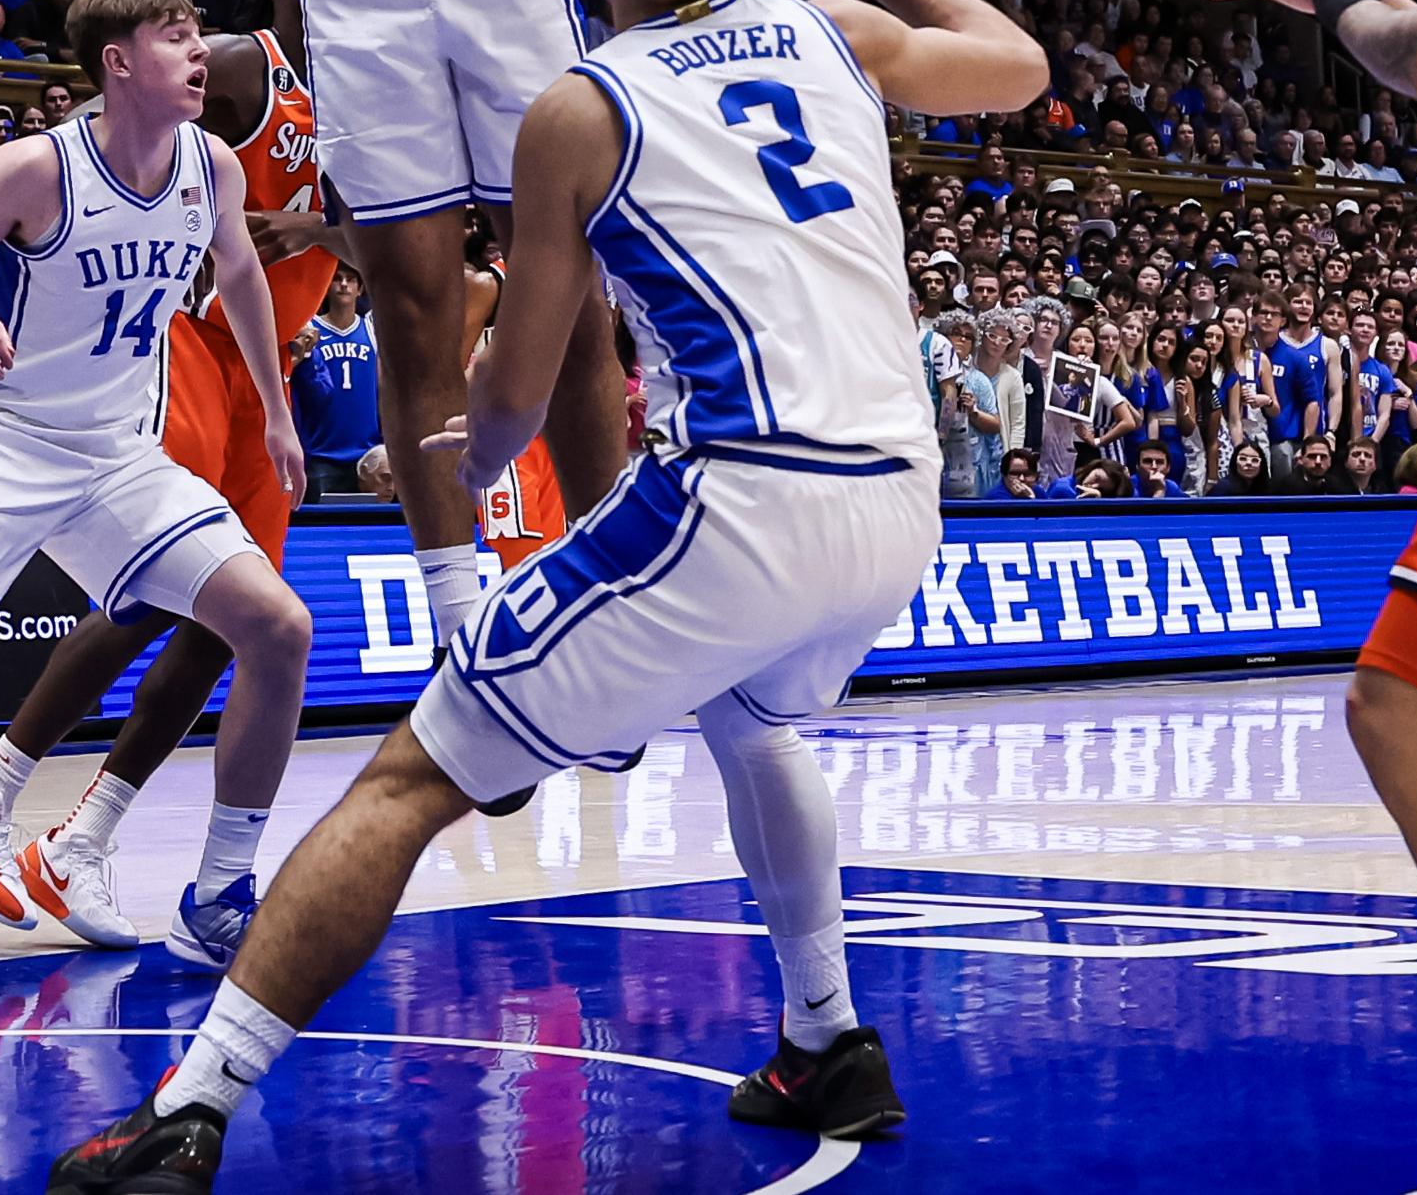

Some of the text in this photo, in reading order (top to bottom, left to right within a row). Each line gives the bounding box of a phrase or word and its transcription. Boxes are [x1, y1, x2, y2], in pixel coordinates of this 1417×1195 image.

[648, 23, 801, 77] BOOZER
[717, 78, 856, 224] 2
[75, 238, 204, 289] DUKE
[90, 287, 167, 358] 14
[320, 342, 371, 362] DUKE
[340, 361, 354, 391] 1
[491, 491, 511, 519] S
[503, 565, 558, 633] D
[871, 533, 1322, 649] KETBALL
